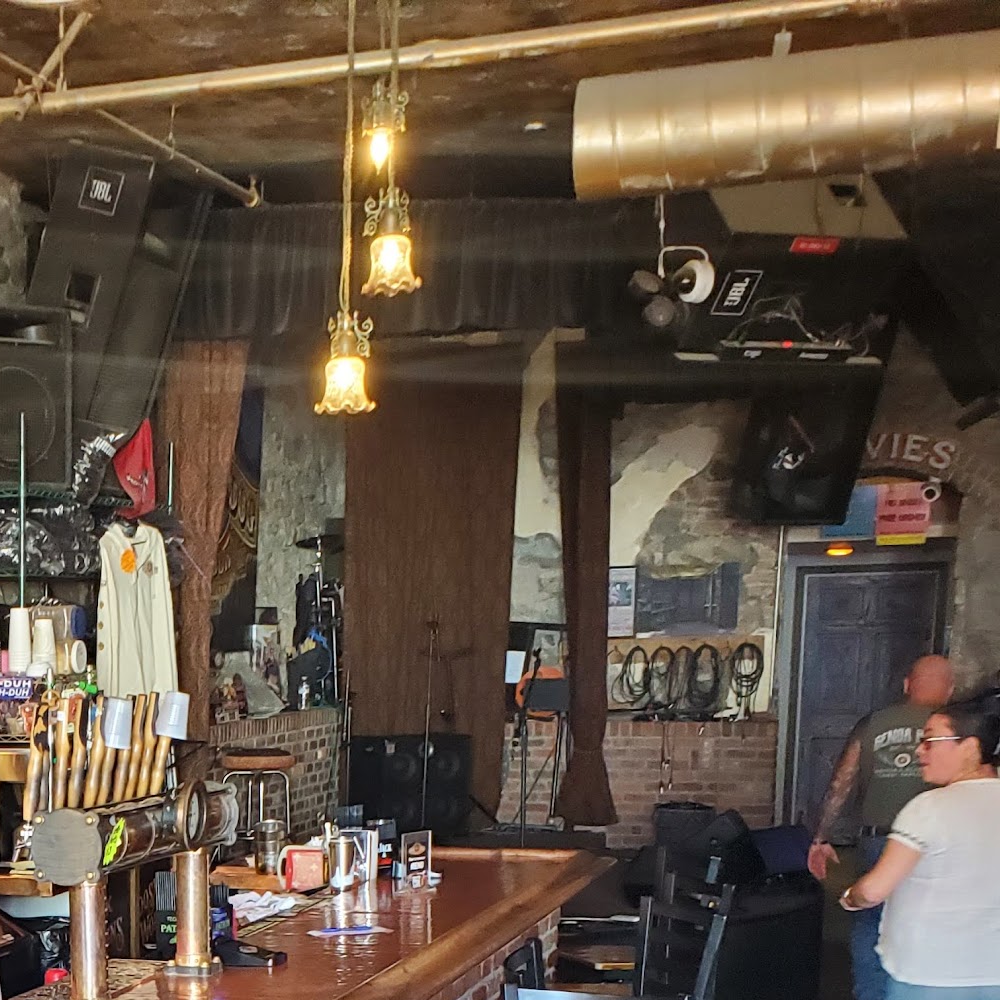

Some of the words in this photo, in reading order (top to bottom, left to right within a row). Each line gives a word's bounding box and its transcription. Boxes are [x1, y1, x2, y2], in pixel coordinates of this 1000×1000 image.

[90, 179, 112, 203] JBL
[723, 277, 751, 306] JBL
[866, 433, 956, 469] VIES
